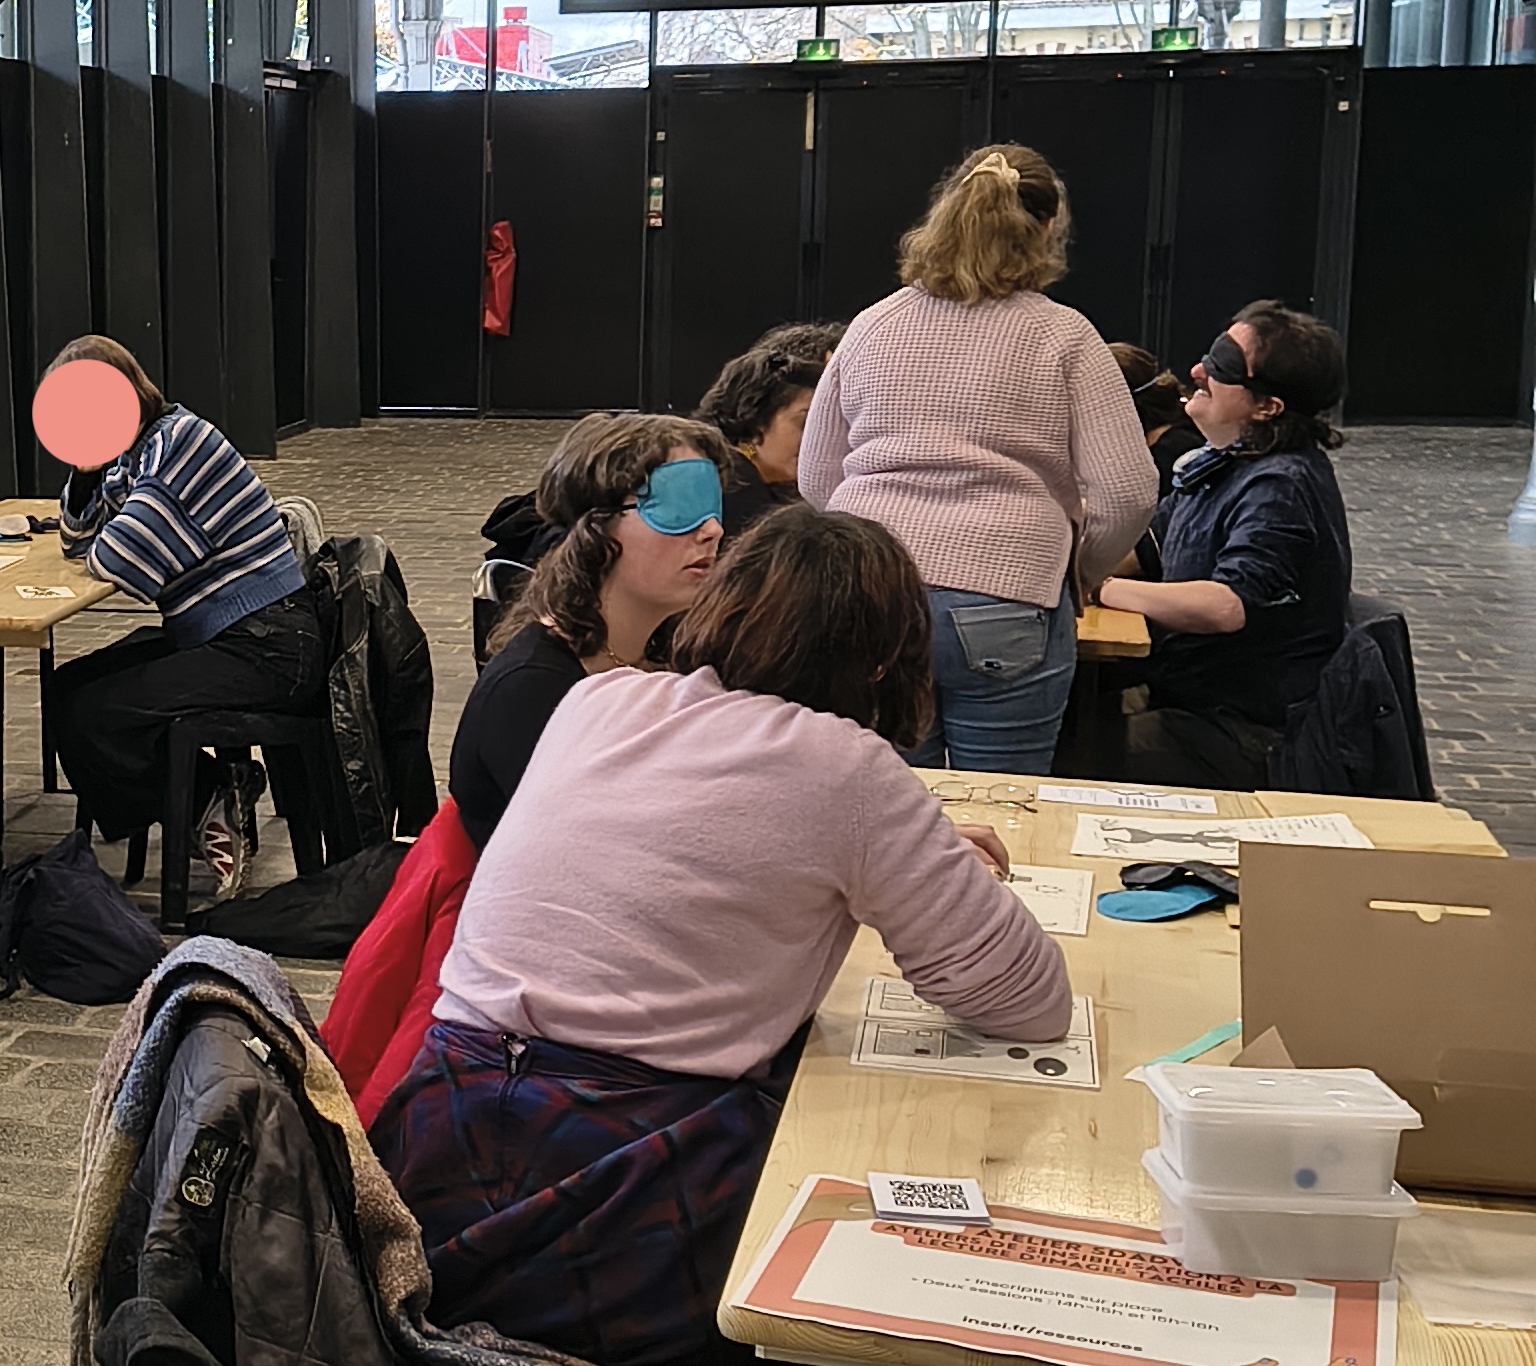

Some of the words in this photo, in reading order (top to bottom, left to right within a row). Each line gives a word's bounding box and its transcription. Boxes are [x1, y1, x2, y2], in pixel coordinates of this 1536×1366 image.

[884, 1224, 981, 1245] ATELIERS
[990, 1240, 1017, 1250] DE
[1025, 1245, 1222, 1282] SENSIBILISATION
[1255, 1281, 1283, 1292] LA
[976, 1228, 1082, 1252] ATELIER
[917, 1237, 1011, 1257] LECTURE
[1019, 1252, 1126, 1275] D'IMAGES
[1136, 1270, 1242, 1294] TACTILES
[922, 1278, 964, 1290] Deux
[969, 1286, 1043, 1303] sessions
[1128, 1312, 1146, 1320] et
[1080, 1296, 1108, 1304] sur
[1112, 1301, 1163, 1313] place
